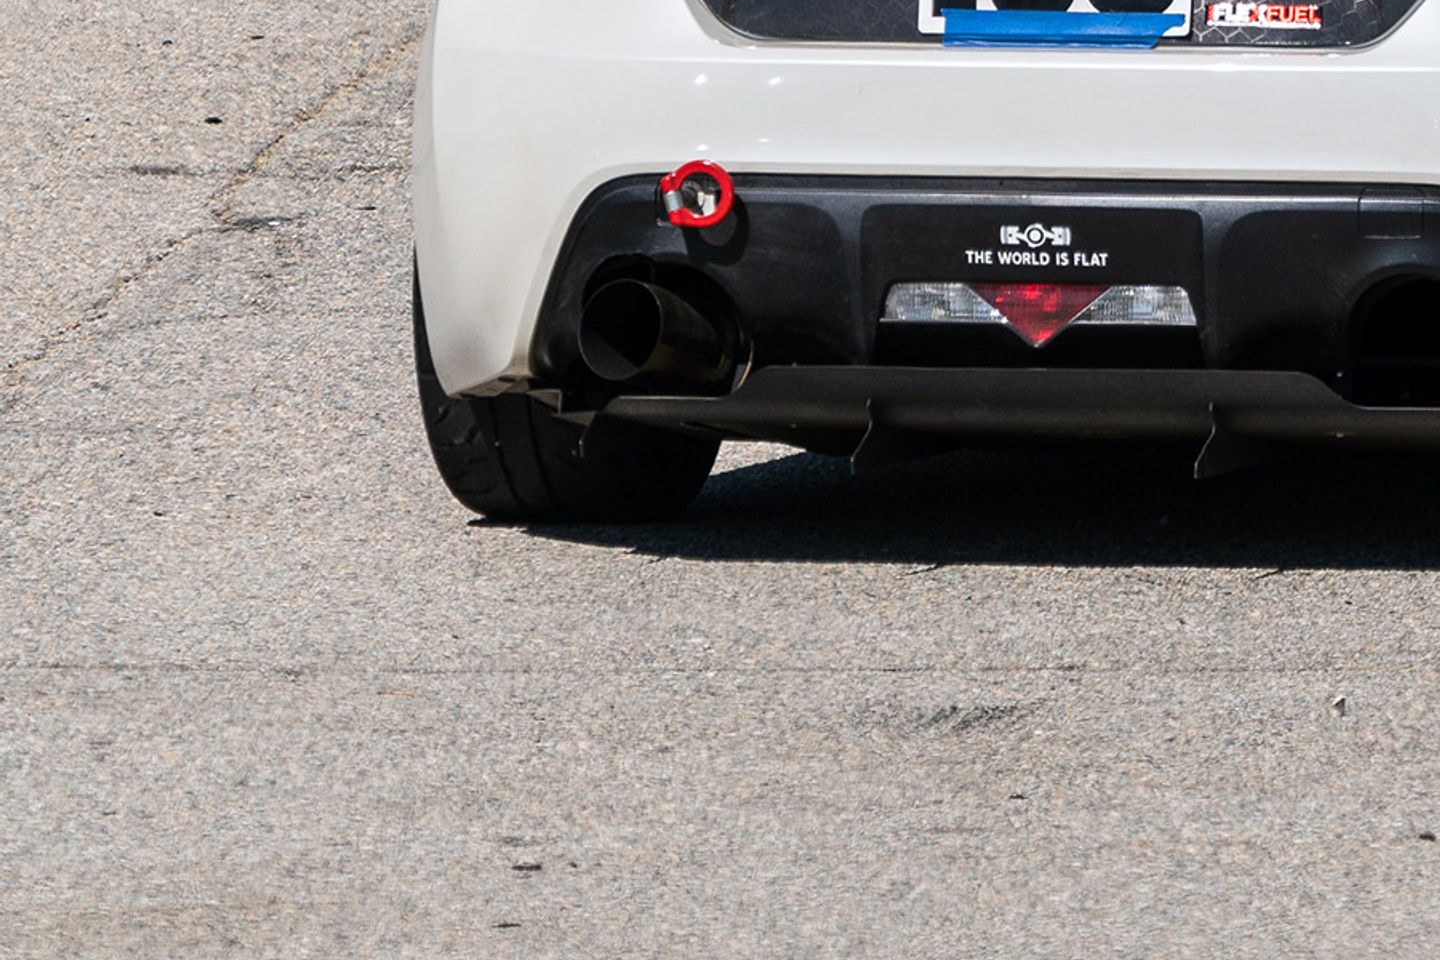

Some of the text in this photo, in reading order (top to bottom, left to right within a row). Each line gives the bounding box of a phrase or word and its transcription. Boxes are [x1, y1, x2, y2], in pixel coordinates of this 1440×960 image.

[965, 249, 1109, 268] THE WORLD IS FLAT
